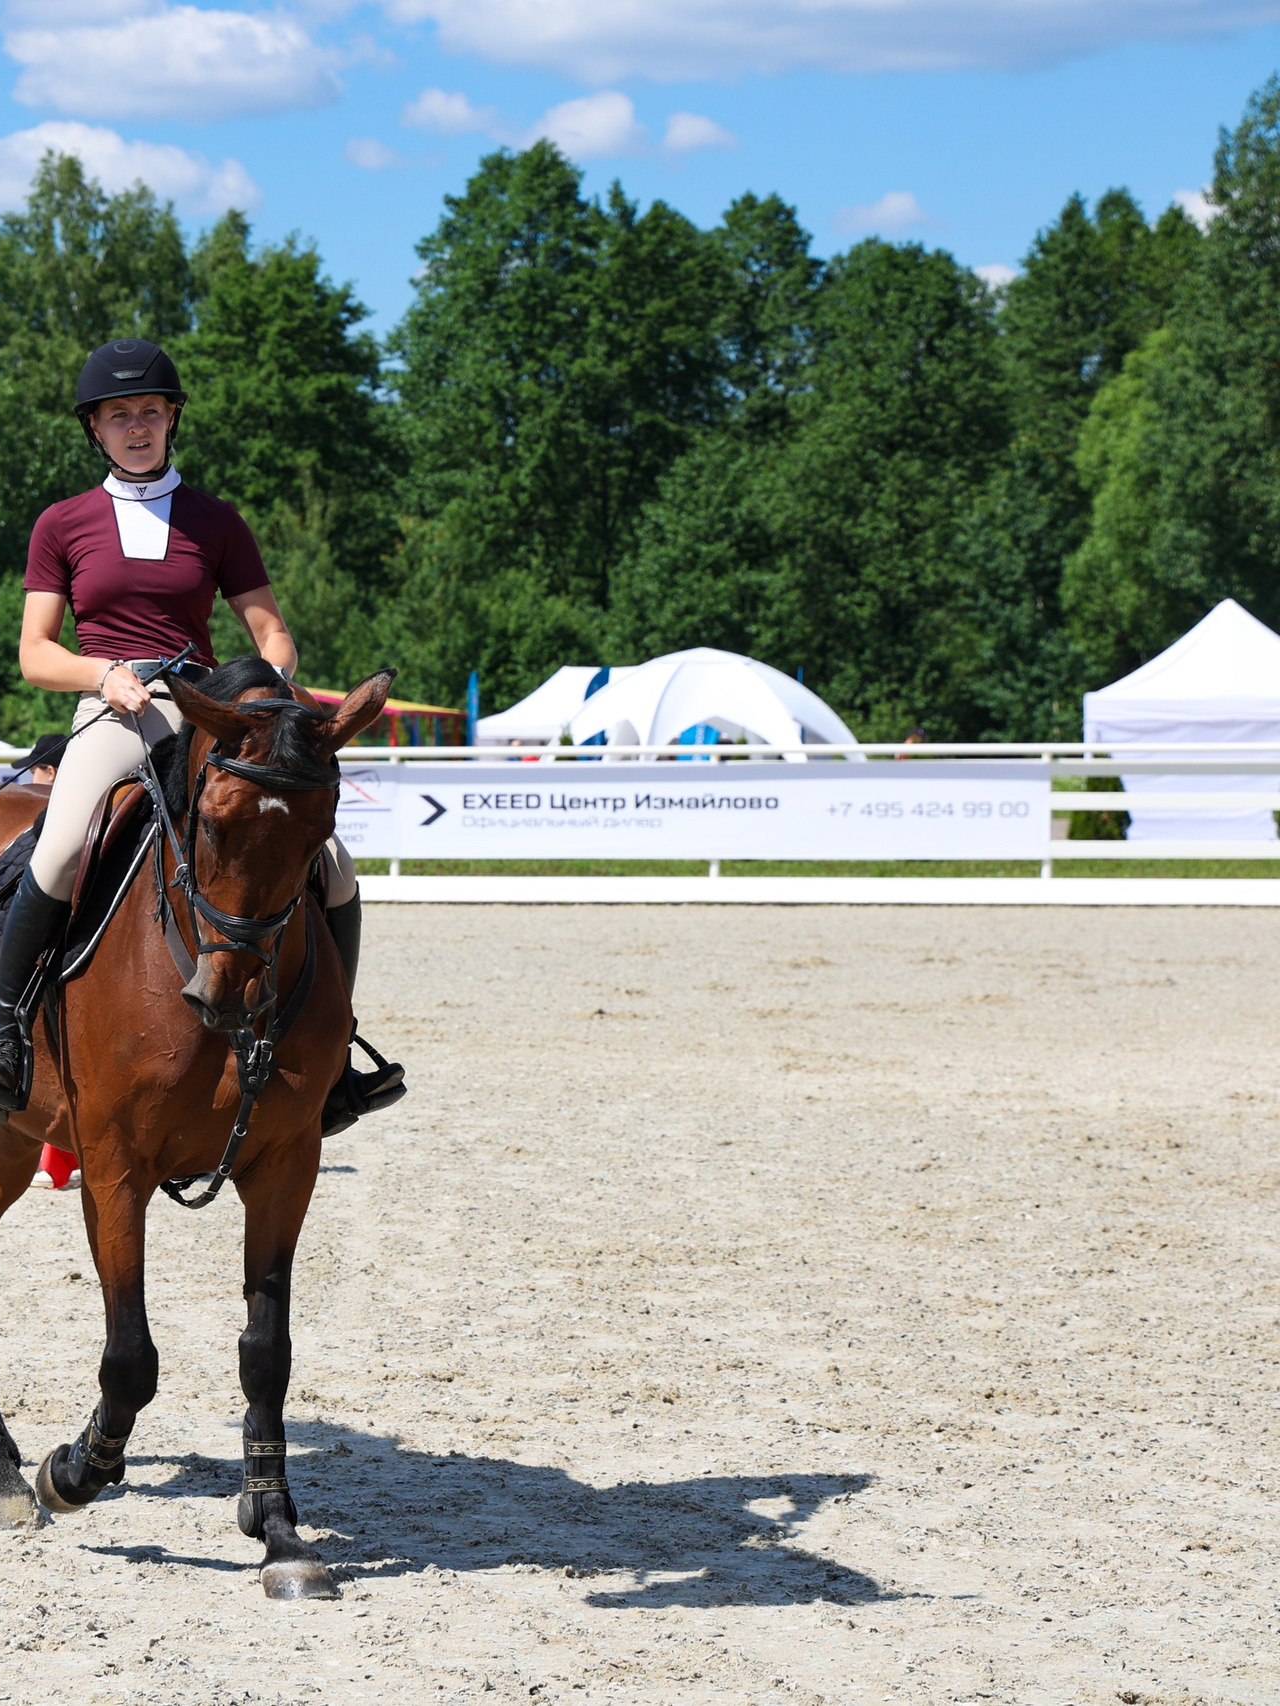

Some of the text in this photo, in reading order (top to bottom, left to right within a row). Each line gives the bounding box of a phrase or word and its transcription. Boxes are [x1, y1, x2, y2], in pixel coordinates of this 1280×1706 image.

[463, 793, 780, 812] EXEED Центр Измайлово
[827, 801, 1030, 818] +7 495 424 99 00
